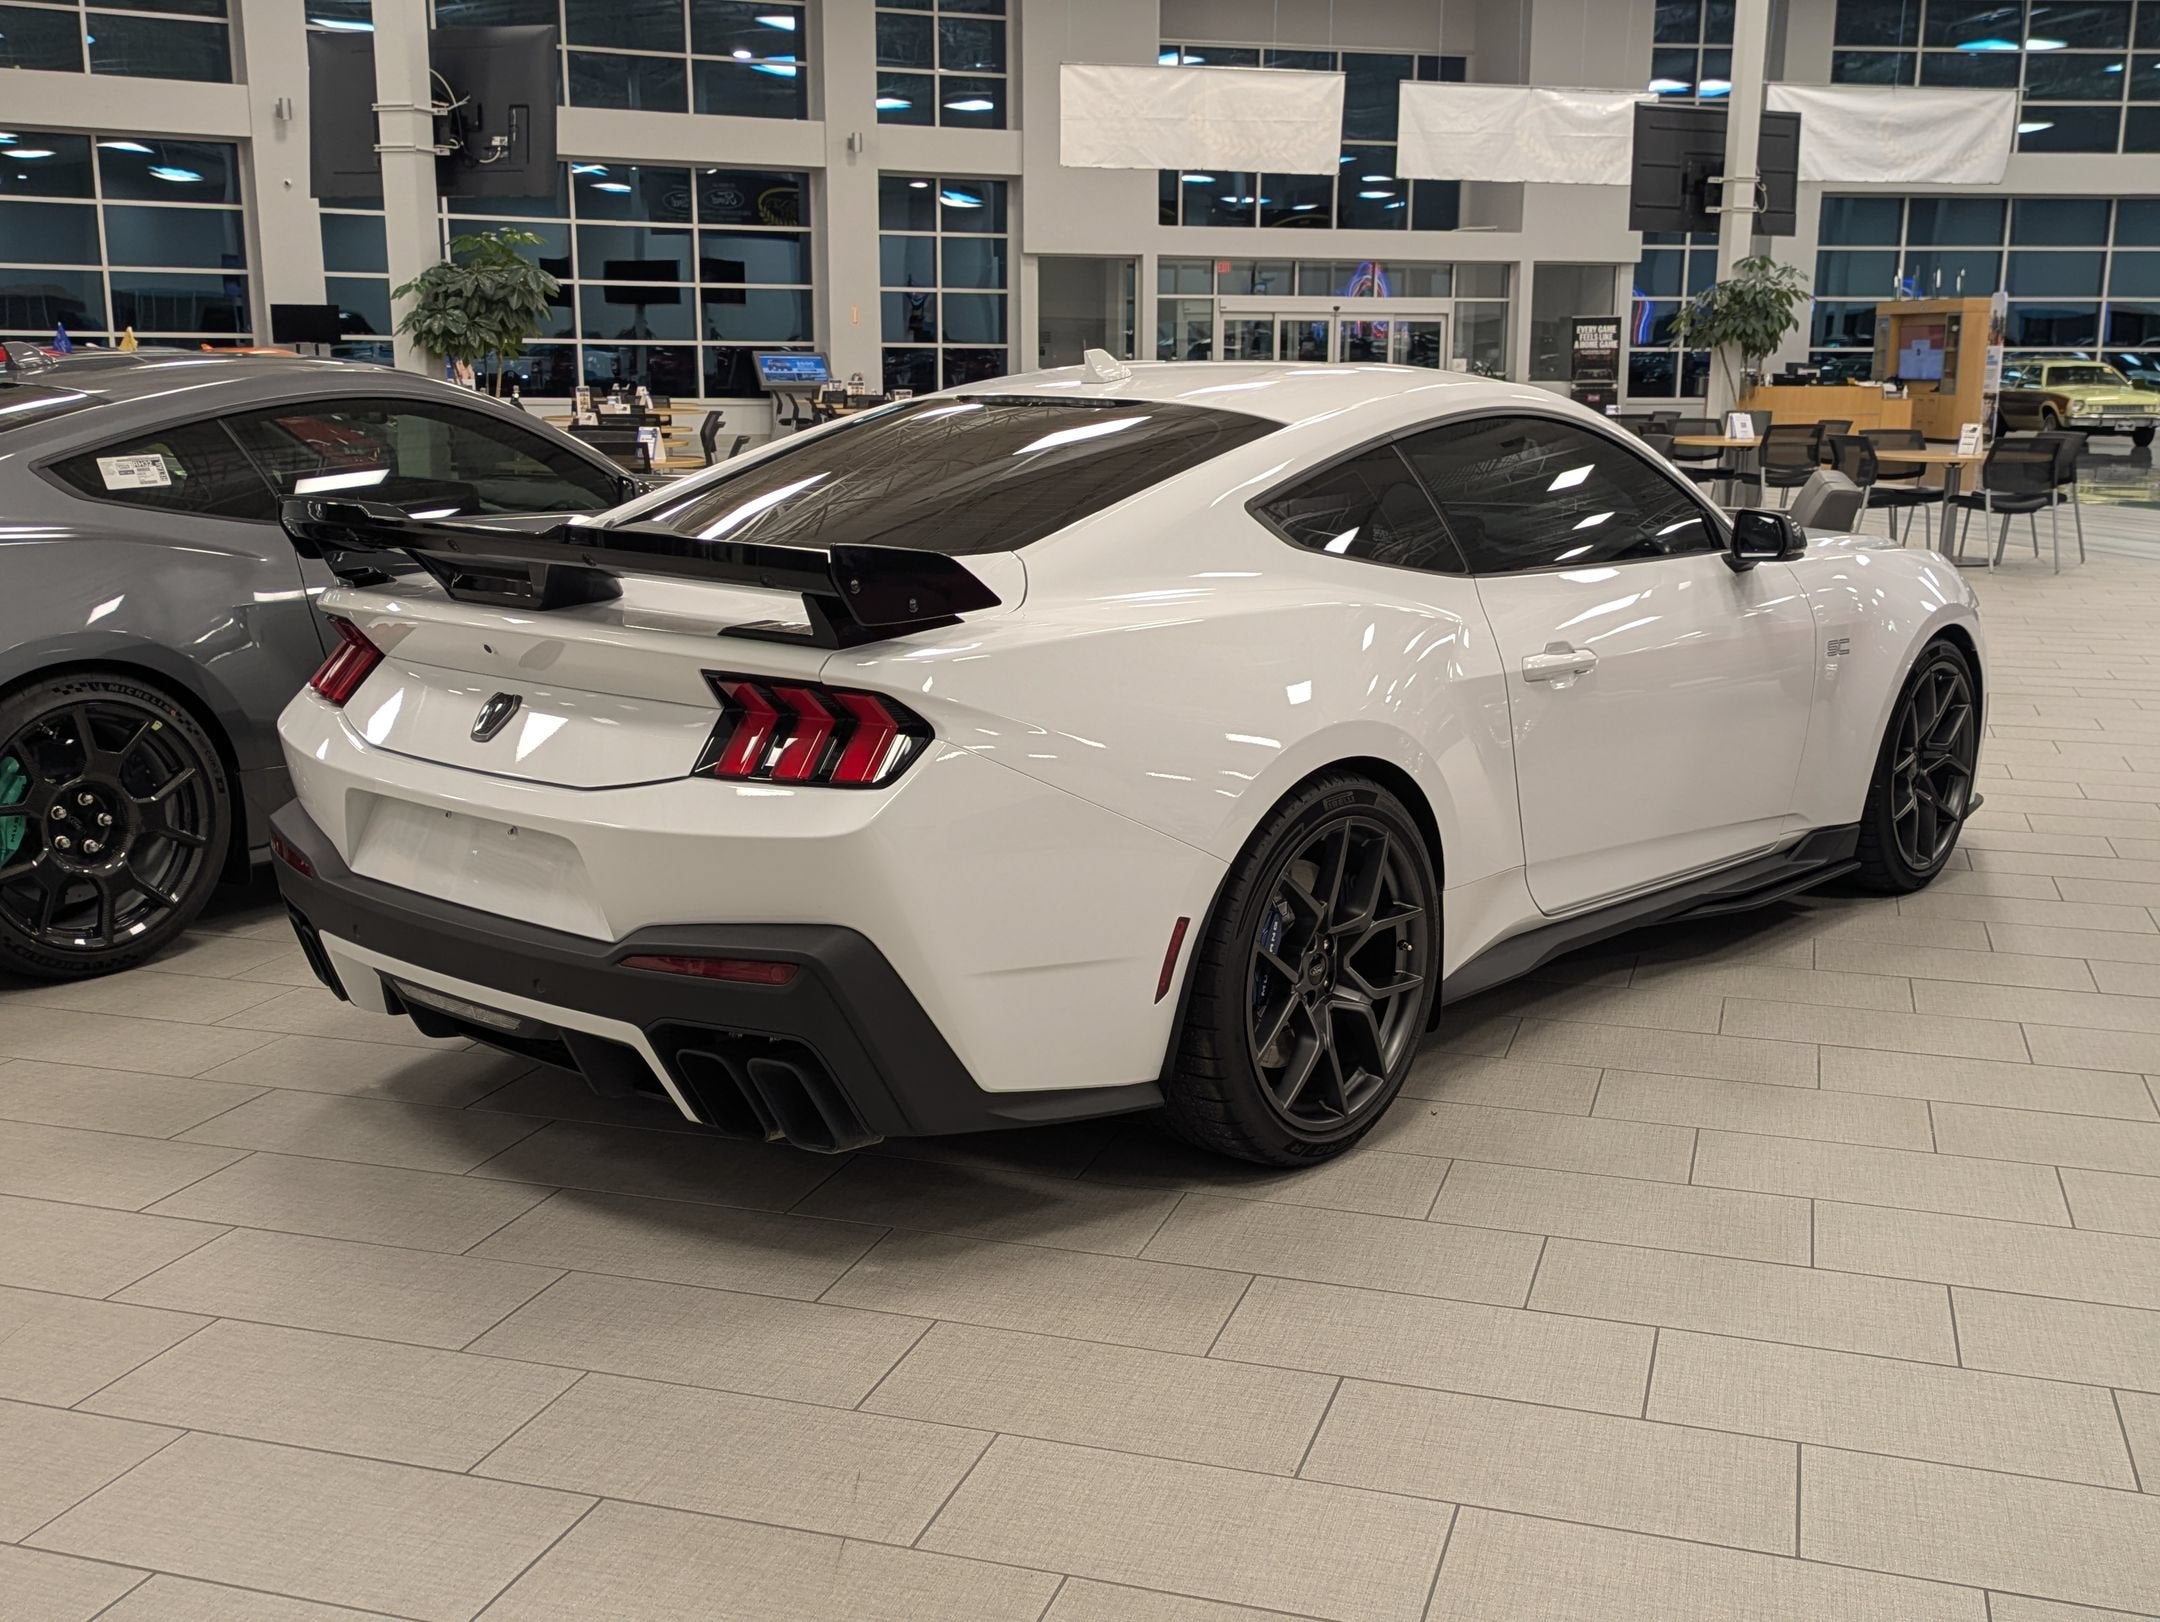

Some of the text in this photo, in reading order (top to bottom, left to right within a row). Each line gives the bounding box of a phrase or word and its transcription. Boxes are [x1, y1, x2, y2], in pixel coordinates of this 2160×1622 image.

[1576, 324, 1617, 334] EVERY GAME
[1579, 333, 1613, 342] FEELS LIKE
[1574, 339, 1618, 349] A HOME GAME
[108, 684, 171, 713] MICHELIN
[1322, 790, 1355, 811] PIRELLI
